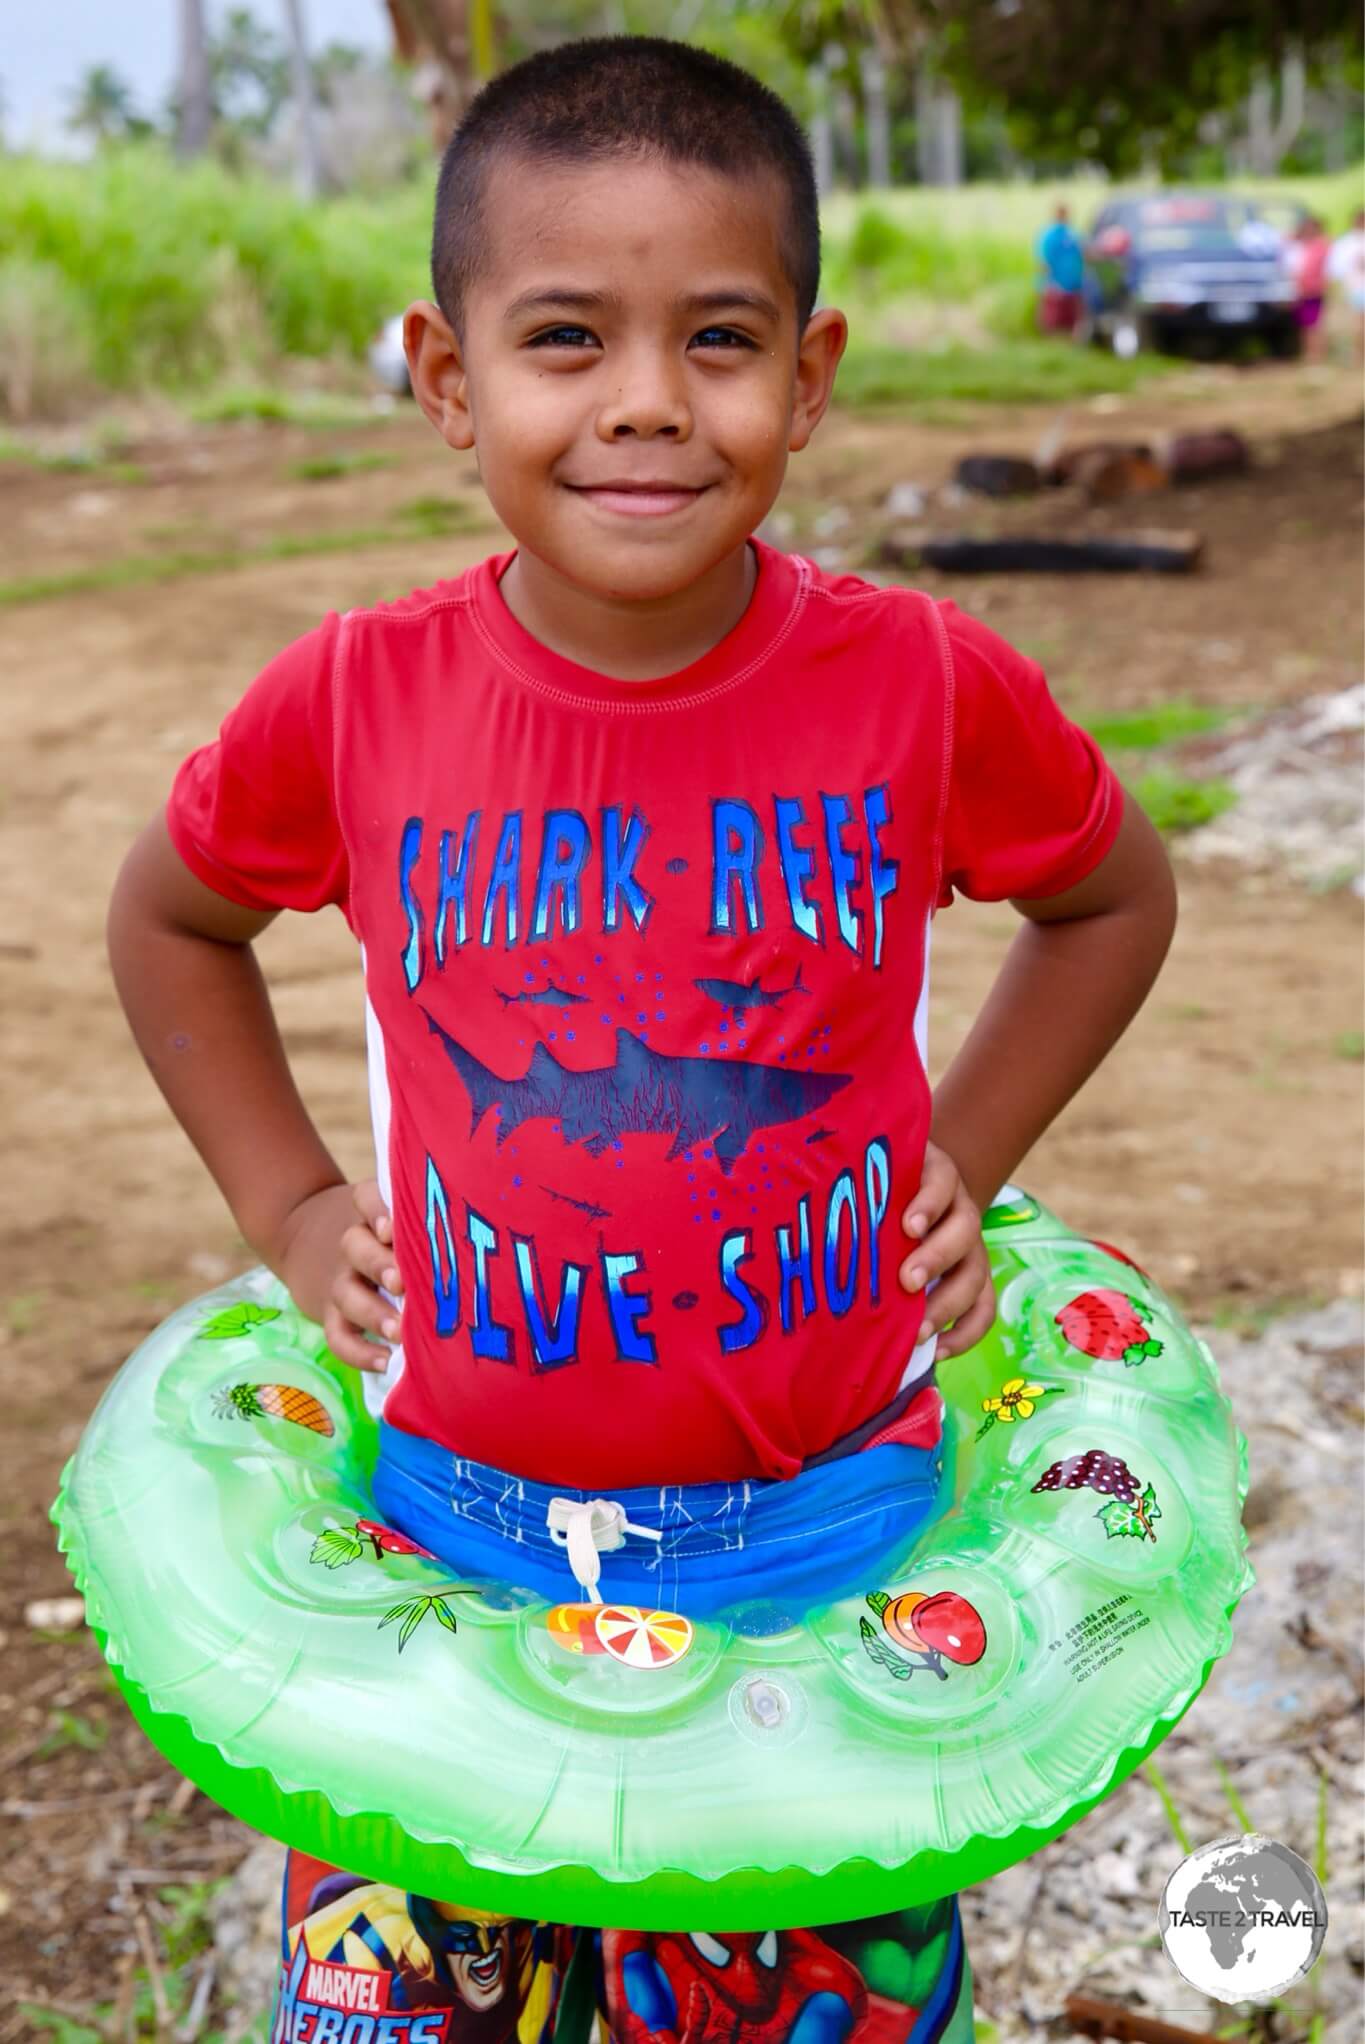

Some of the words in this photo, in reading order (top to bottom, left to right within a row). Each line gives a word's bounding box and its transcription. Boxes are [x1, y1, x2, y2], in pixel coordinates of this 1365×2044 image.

[399, 804, 656, 997] SHARK
[707, 782, 900, 972] REEF
[425, 1148, 661, 1376] DIVE
[716, 1133, 893, 1357] SHOP
[306, 1963, 380, 2012] MARVEL
